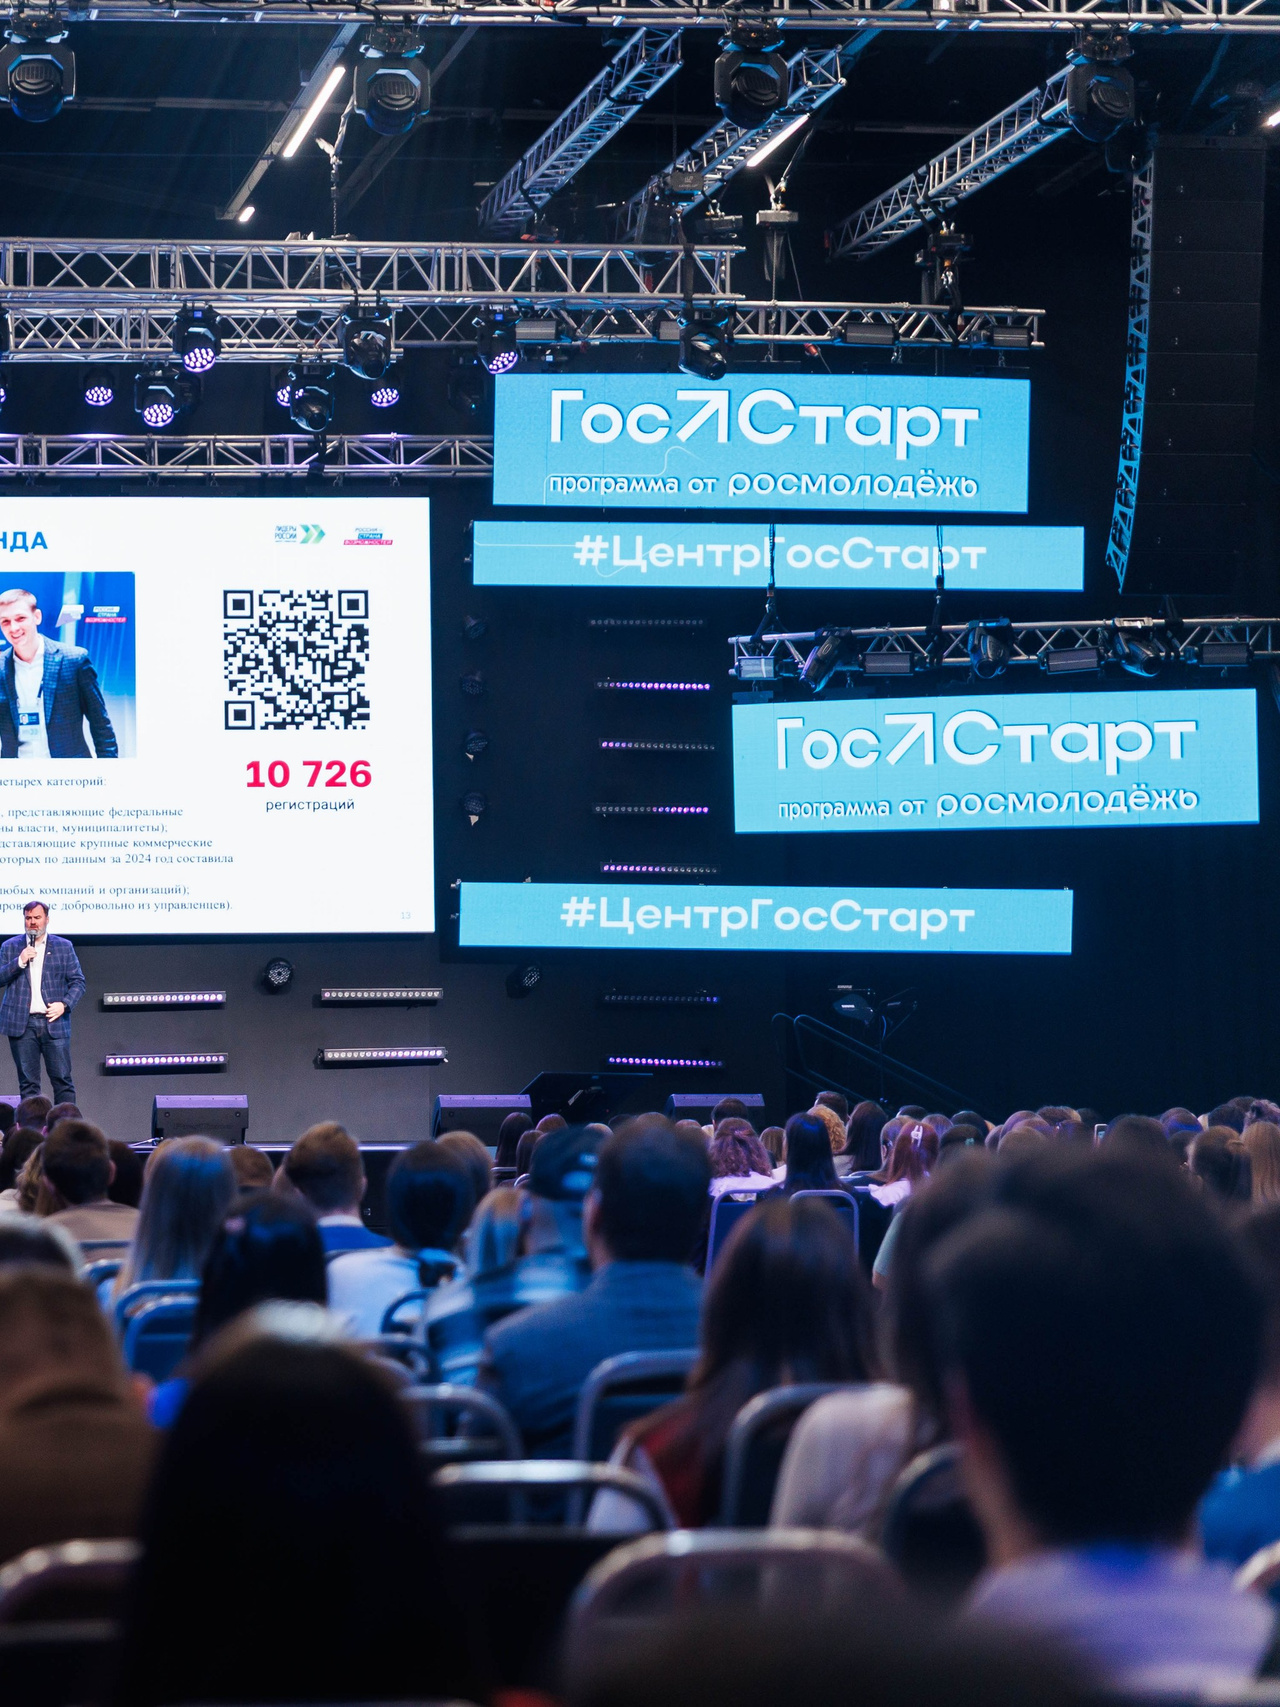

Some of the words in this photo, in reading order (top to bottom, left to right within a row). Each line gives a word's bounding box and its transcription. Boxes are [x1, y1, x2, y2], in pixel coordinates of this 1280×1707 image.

[549, 474, 680, 496] программа
[687, 476, 719, 494] от
[727, 469, 979, 499] росмолодёжь
[246, 760, 290, 788] 10
[302, 760, 372, 788] 726
[46, 776, 107, 788] категорий:
[266, 799, 355, 813] регистраций
[778, 799, 891, 820] программа
[899, 799, 926, 816] от
[936, 783, 1199, 817] росмолодёжь
[8, 809, 105, 820] представляющие
[108, 807, 184, 820] федеральные
[17, 825, 59, 834] власти,
[62, 823, 168, 836] муниципалитеты);
[80, 840, 129, 851] крупные
[133, 840, 213, 849] коммерческие
[44, 856, 59, 864] по
[61, 856, 106, 866] данным
[110, 856, 122, 864] за
[124, 853, 152, 864] 2024
[155, 855, 174, 865] год
[177, 855, 234, 864] составила
[39, 885, 95, 895] компаний
[109, 885, 190, 898] организаций);
[61, 900, 135, 911] добровольно
[138, 902, 151, 910] из
[154, 901, 233, 913] управленцев).
[401, 911, 412, 920] 13
[560, 896, 976, 940] #ЦентрГосСтарт
